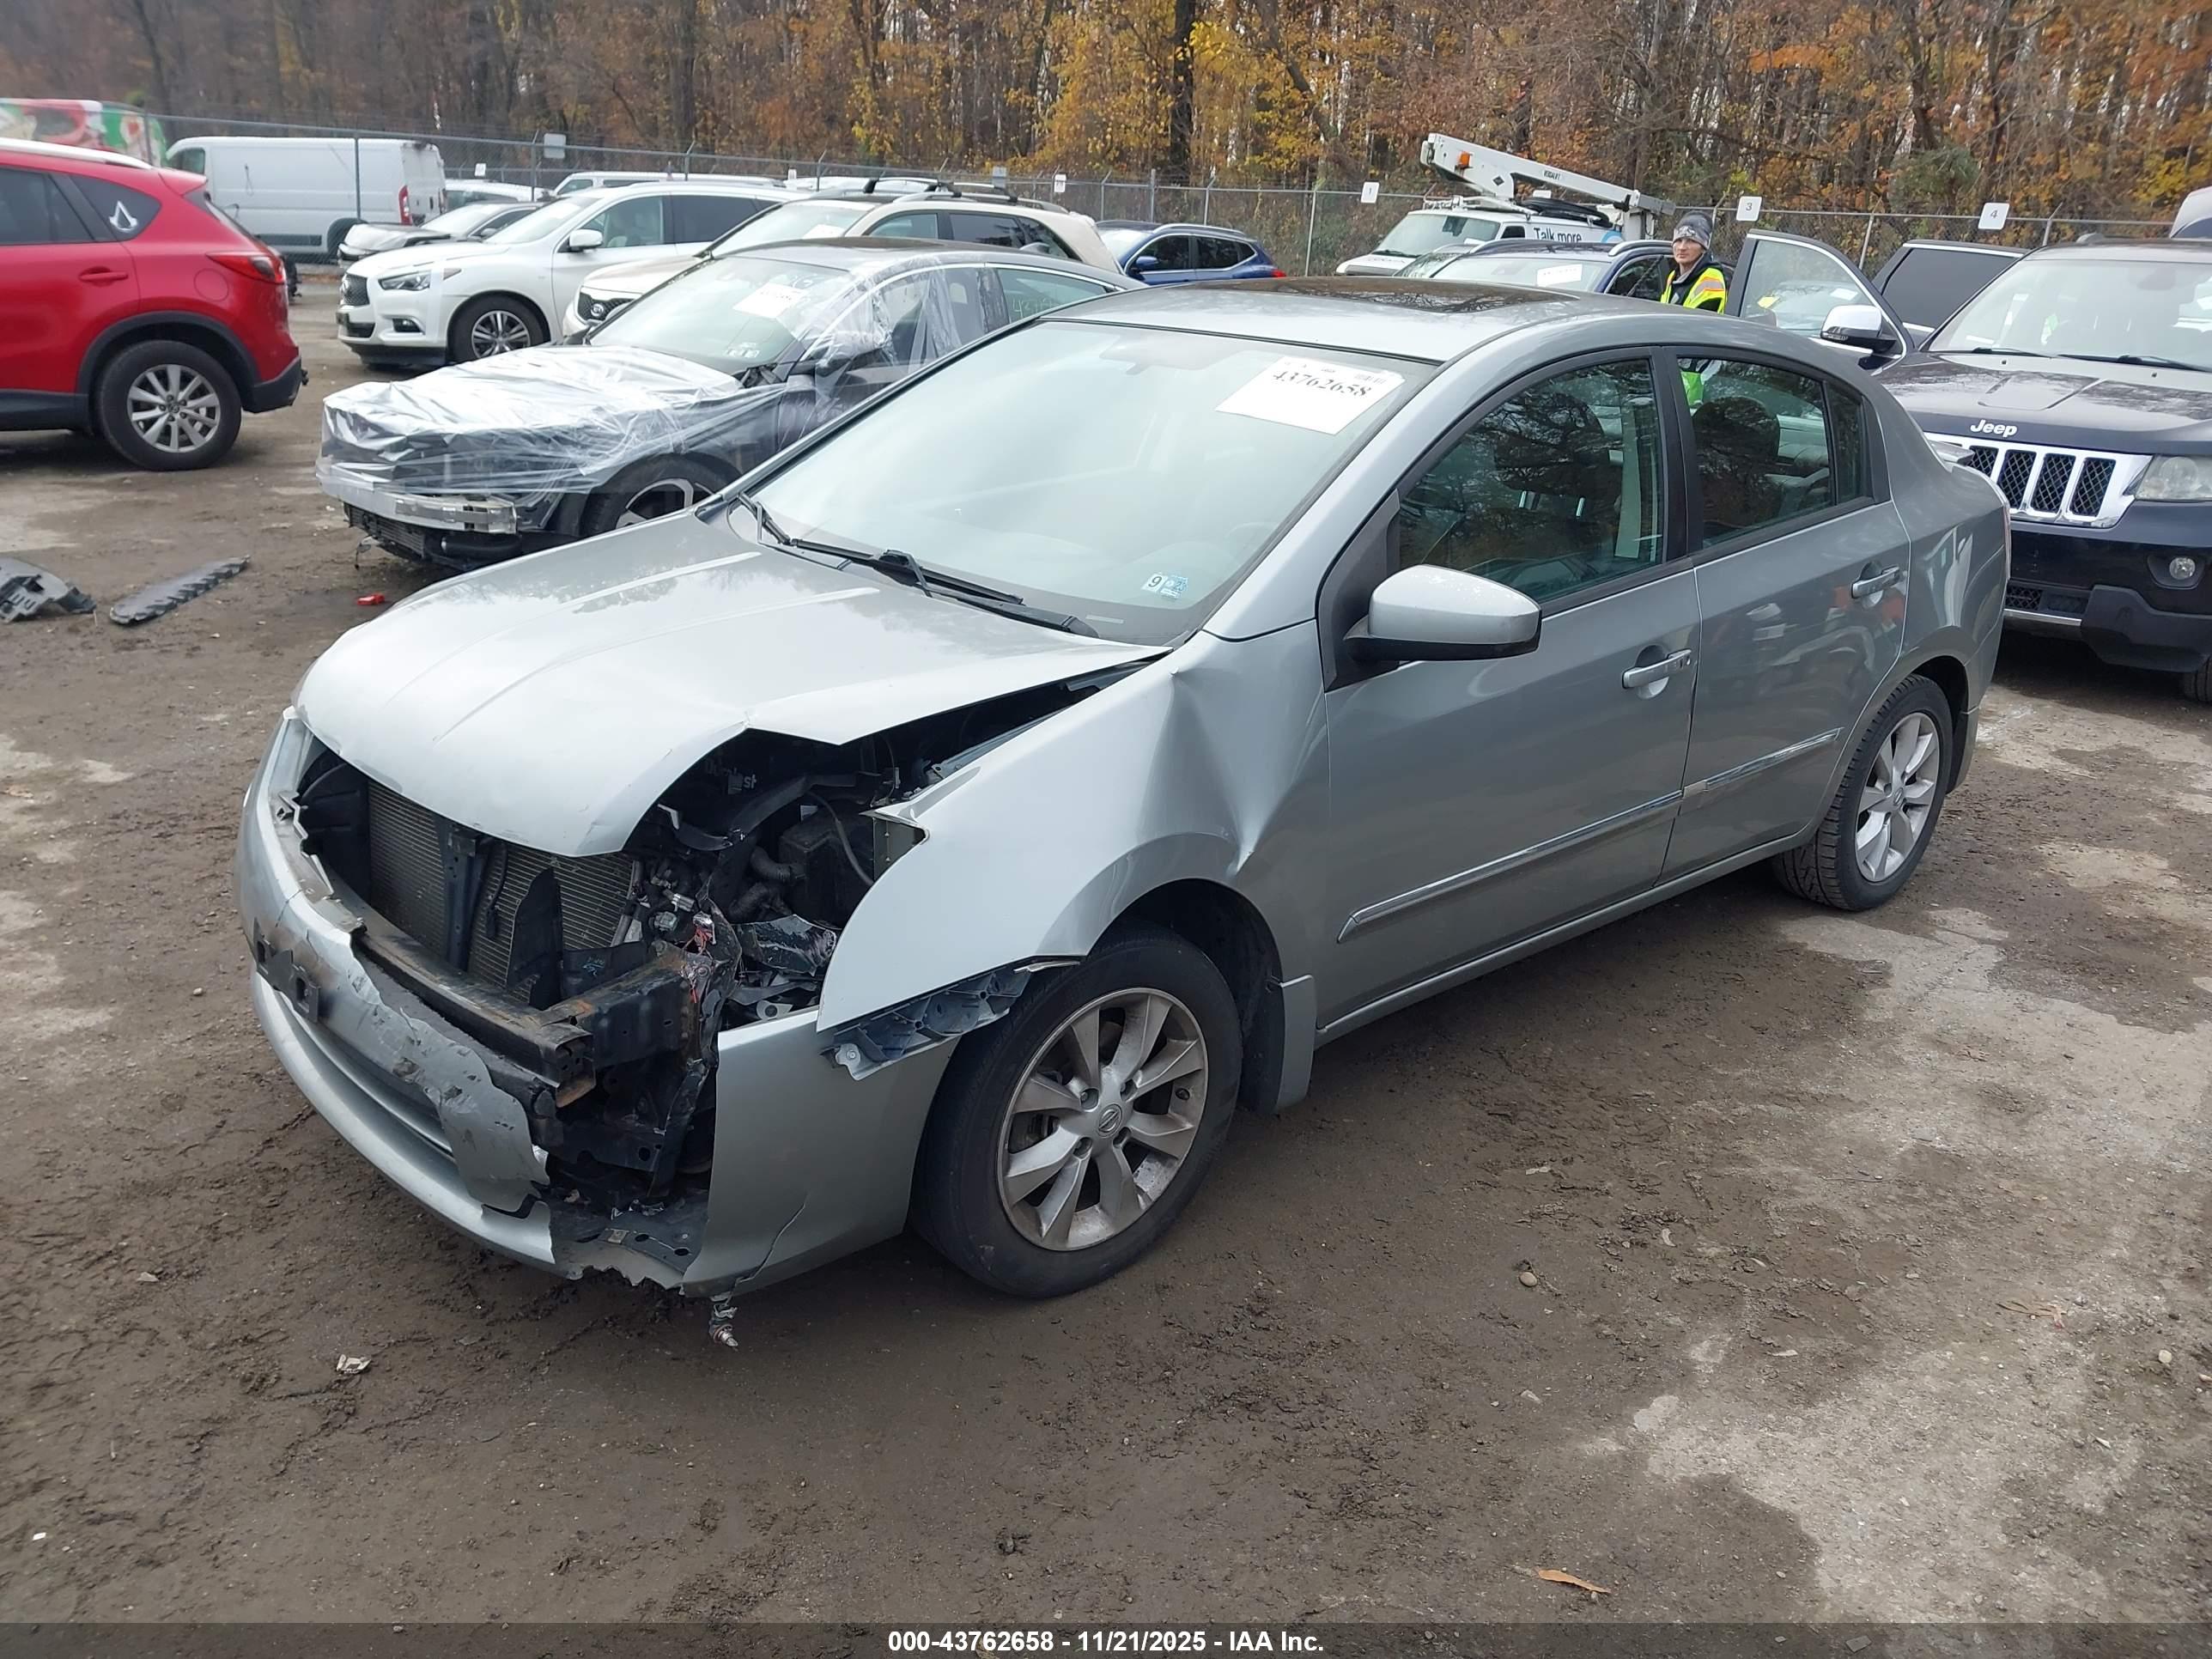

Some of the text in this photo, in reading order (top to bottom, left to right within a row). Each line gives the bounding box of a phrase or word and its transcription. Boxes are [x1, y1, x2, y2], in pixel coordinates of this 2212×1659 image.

[1745, 202, 1753, 211] 3
[1990, 210, 1998, 219] 4
[1533, 227, 1583, 244] Talk more
[1273, 370, 1372, 398] 43762658
[1969, 419, 2018, 438] Jeep
[1147, 575, 1163, 588] 9
